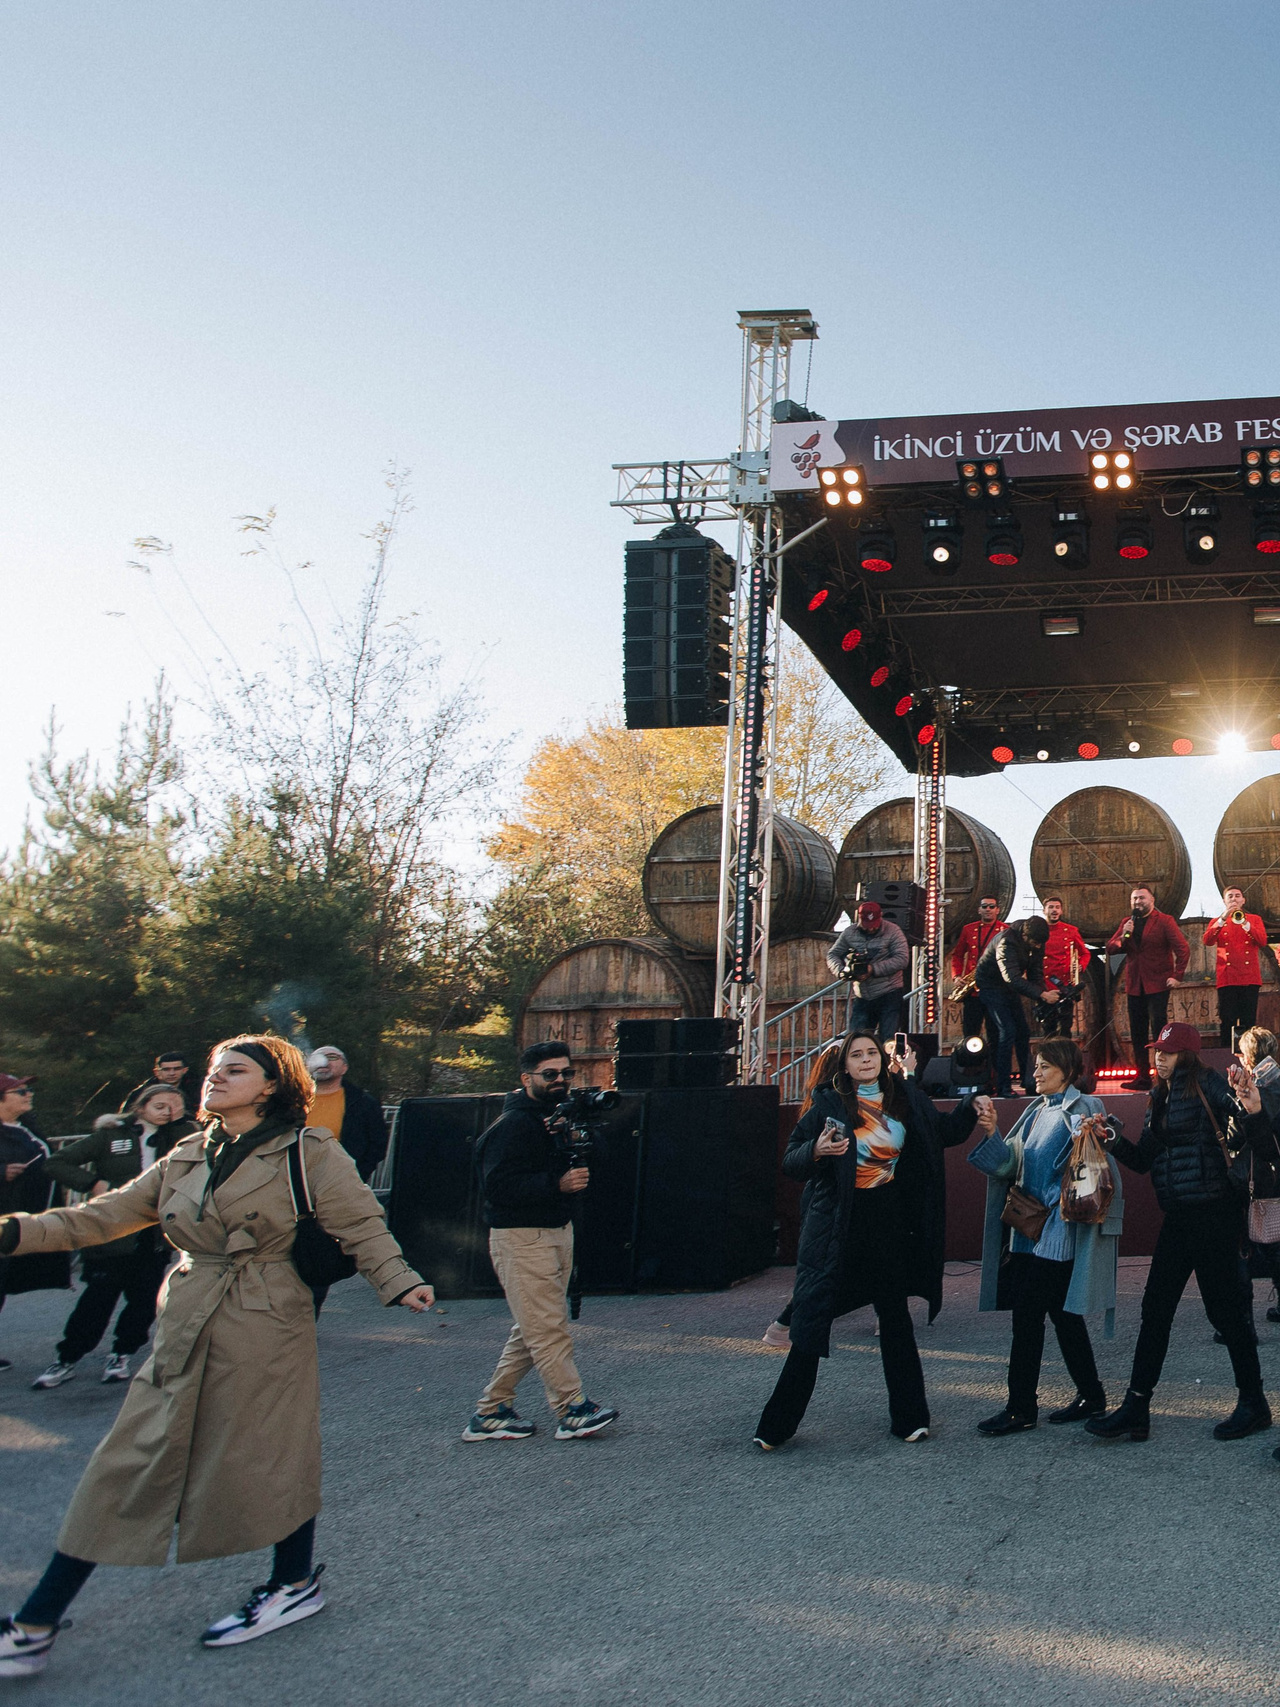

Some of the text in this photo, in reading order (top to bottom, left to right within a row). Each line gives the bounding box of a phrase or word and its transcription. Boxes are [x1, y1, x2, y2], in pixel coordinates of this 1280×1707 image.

[873, 430, 964, 461] İKİNCİ
[975, 426, 1062, 456] ÜZÜM
[1071, 428, 1113, 451] VƏ
[1124, 421, 1224, 452] ŞƏRAB
[853, 861, 973, 883] MEYRI
